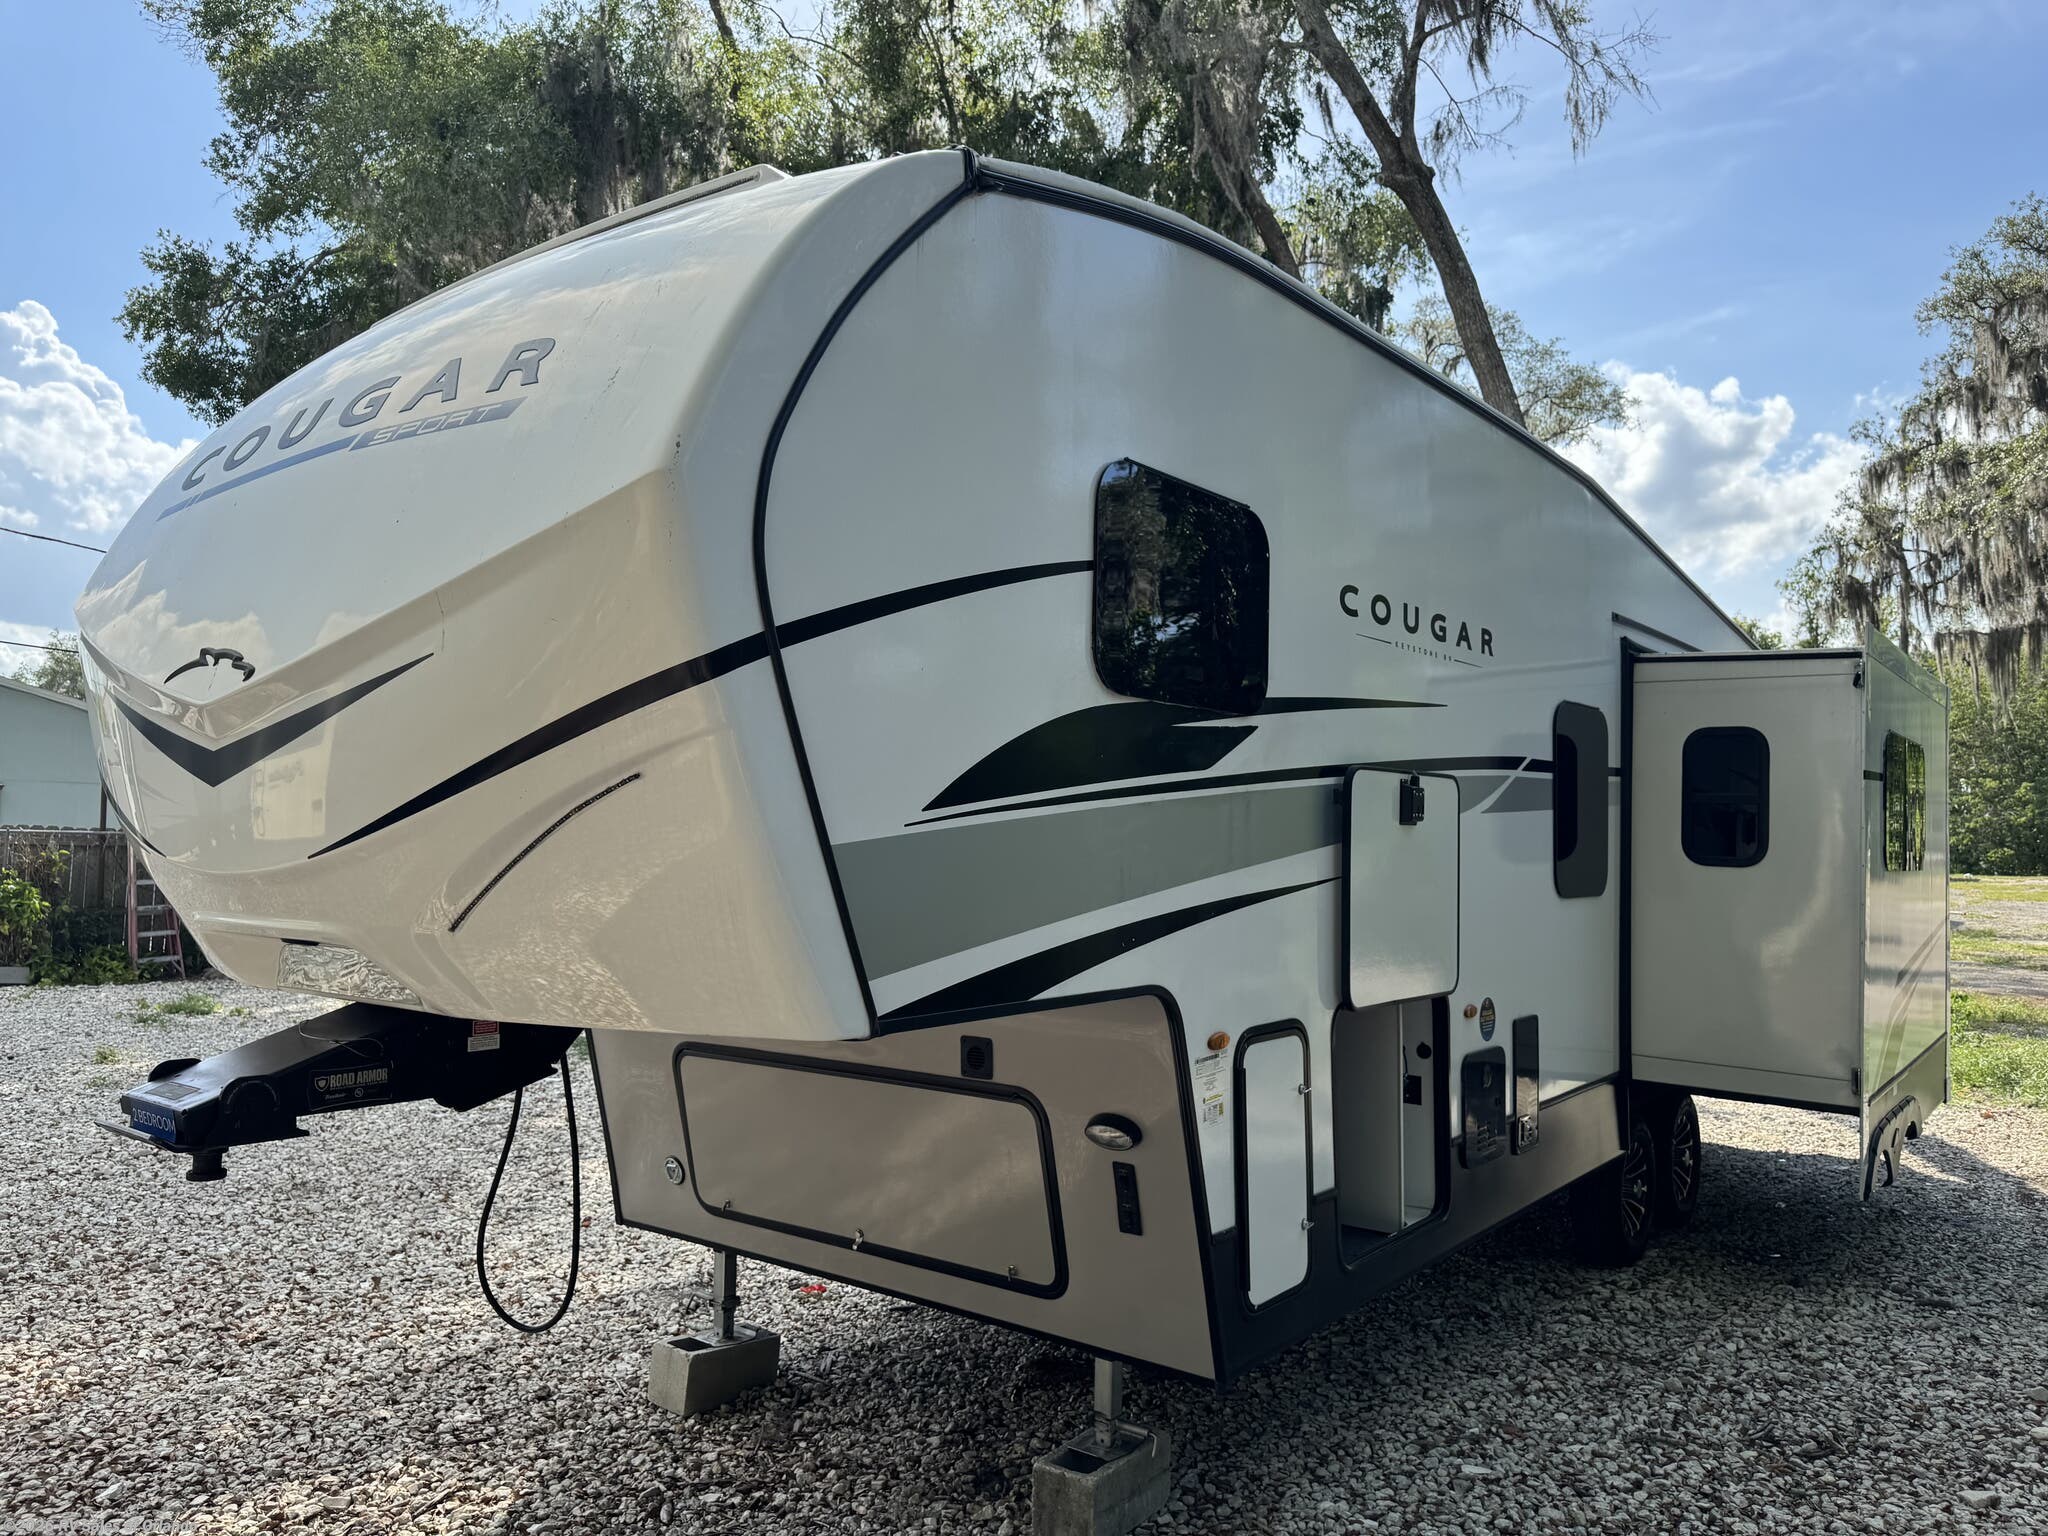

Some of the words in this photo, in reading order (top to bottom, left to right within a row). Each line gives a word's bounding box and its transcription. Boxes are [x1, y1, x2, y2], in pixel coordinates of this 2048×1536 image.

[181, 337, 556, 491] COUGAR
[367, 405, 494, 447] SPORT
[1339, 584, 1494, 657] COUGAR
[329, 1071, 356, 1088] ROAD
[356, 1067, 388, 1084] ARMOR
[132, 1107, 138, 1122] 2
[137, 1109, 177, 1135] BEDROOM
